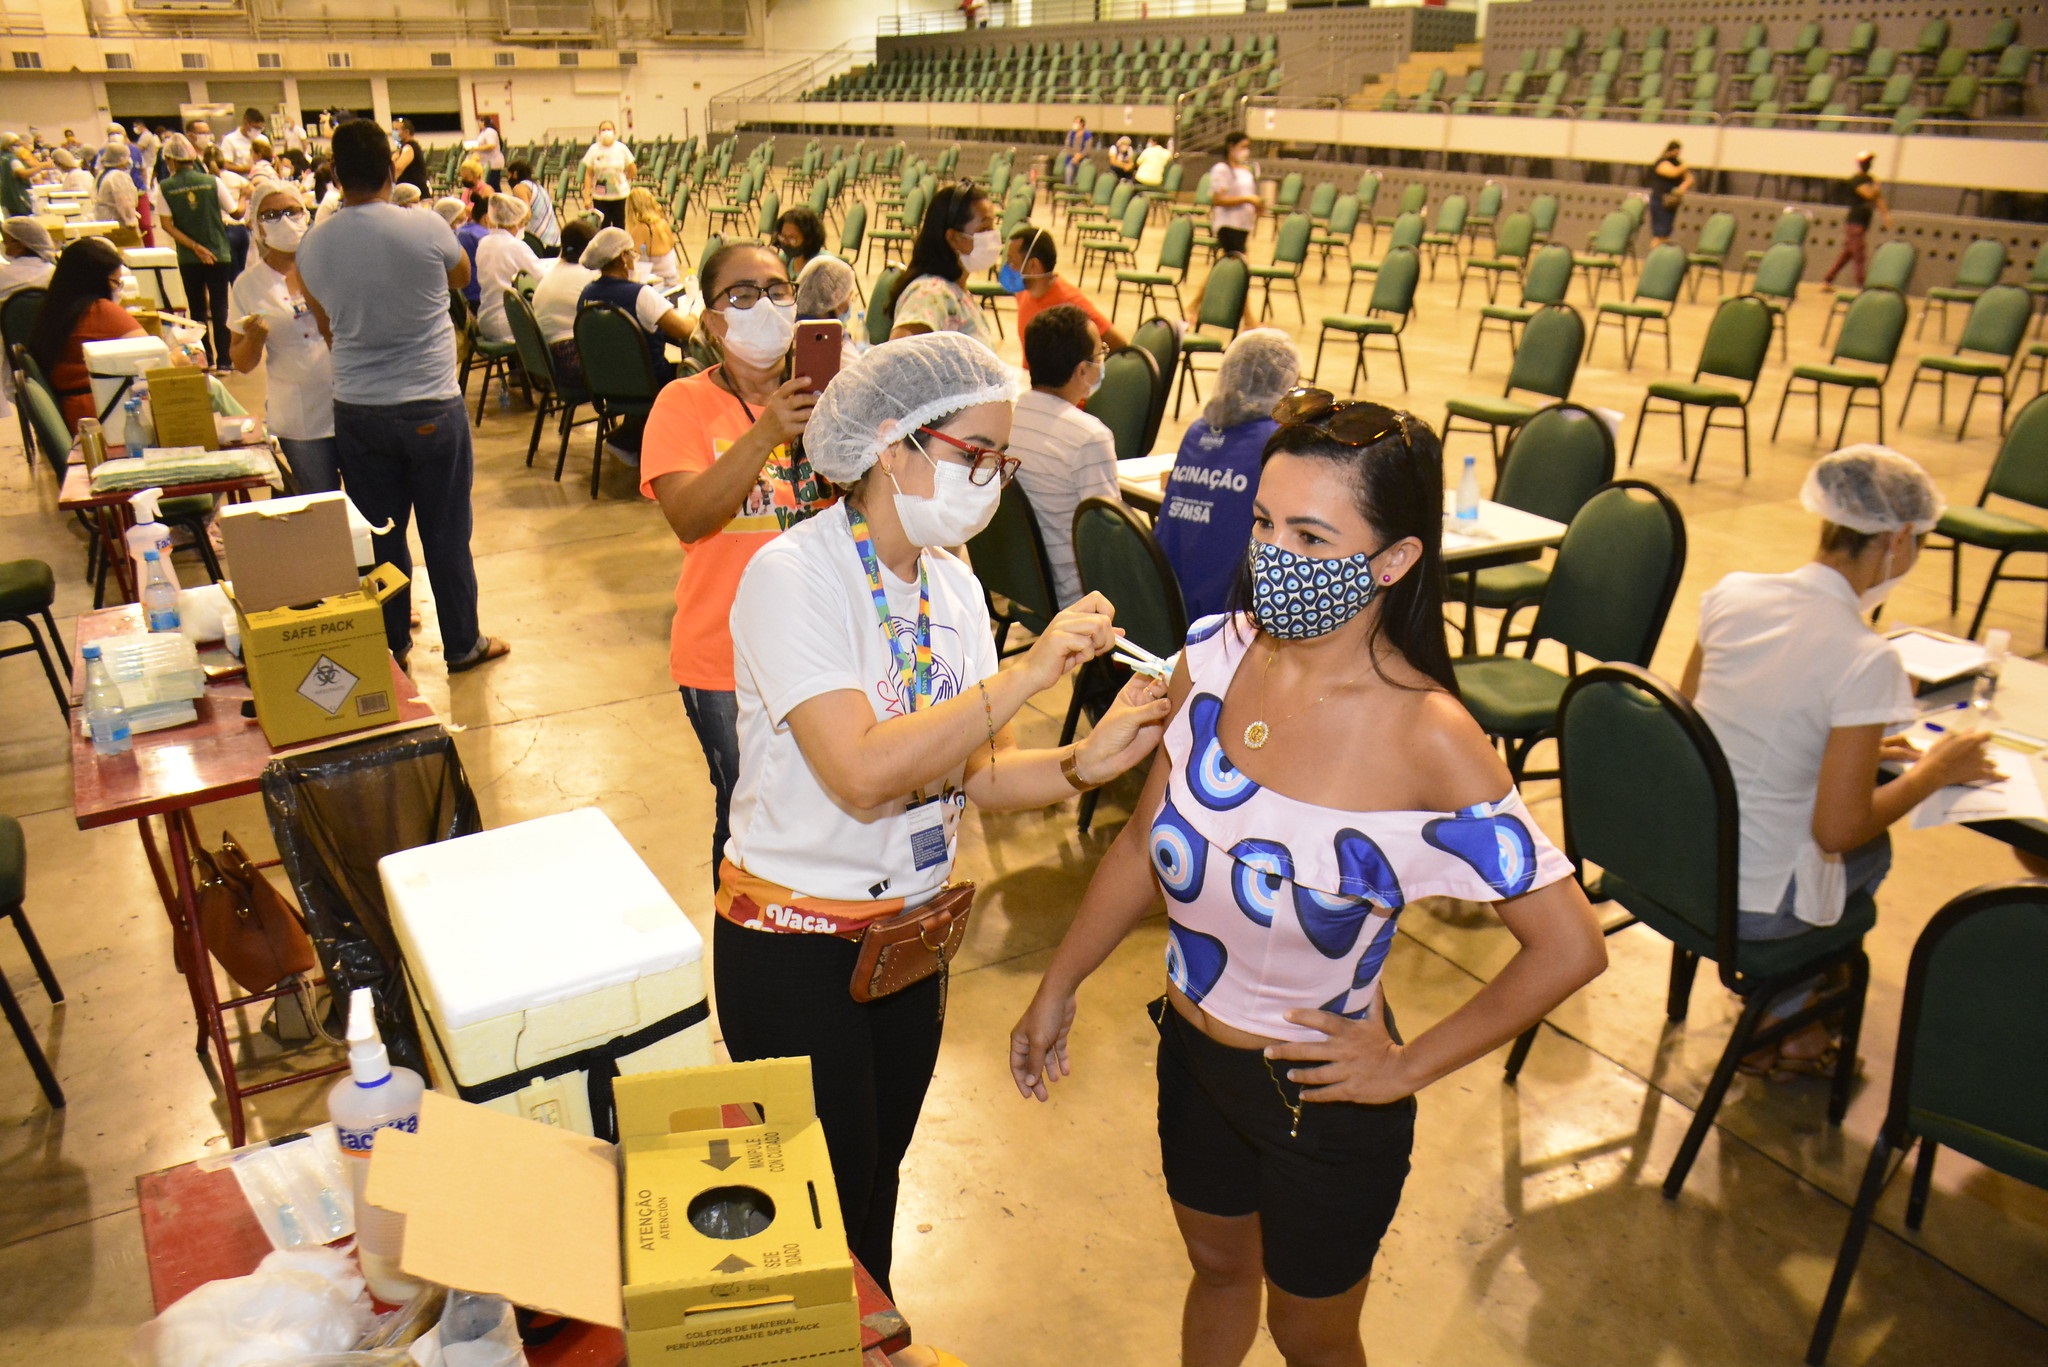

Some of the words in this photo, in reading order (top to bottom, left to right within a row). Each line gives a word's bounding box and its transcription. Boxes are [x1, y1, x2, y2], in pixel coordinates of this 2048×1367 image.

[1168, 501, 1210, 524] SEMSA
[282, 626, 317, 642] SAFE
[321, 619, 355, 635] PACK
[766, 903, 837, 934] Vaca
[635, 1189, 655, 1251] ATENÇÃO
[656, 1196, 670, 1240] ATENCIÓN
[665, 1331, 765, 1351] PERFUROCORTANTE
[767, 1327, 793, 1338] SAFE
[794, 1322, 820, 1333] PACK
[685, 1327, 732, 1340] COLETOR
[734, 1324, 749, 1333] DE
[750, 1317, 799, 1331] MATERIAL
